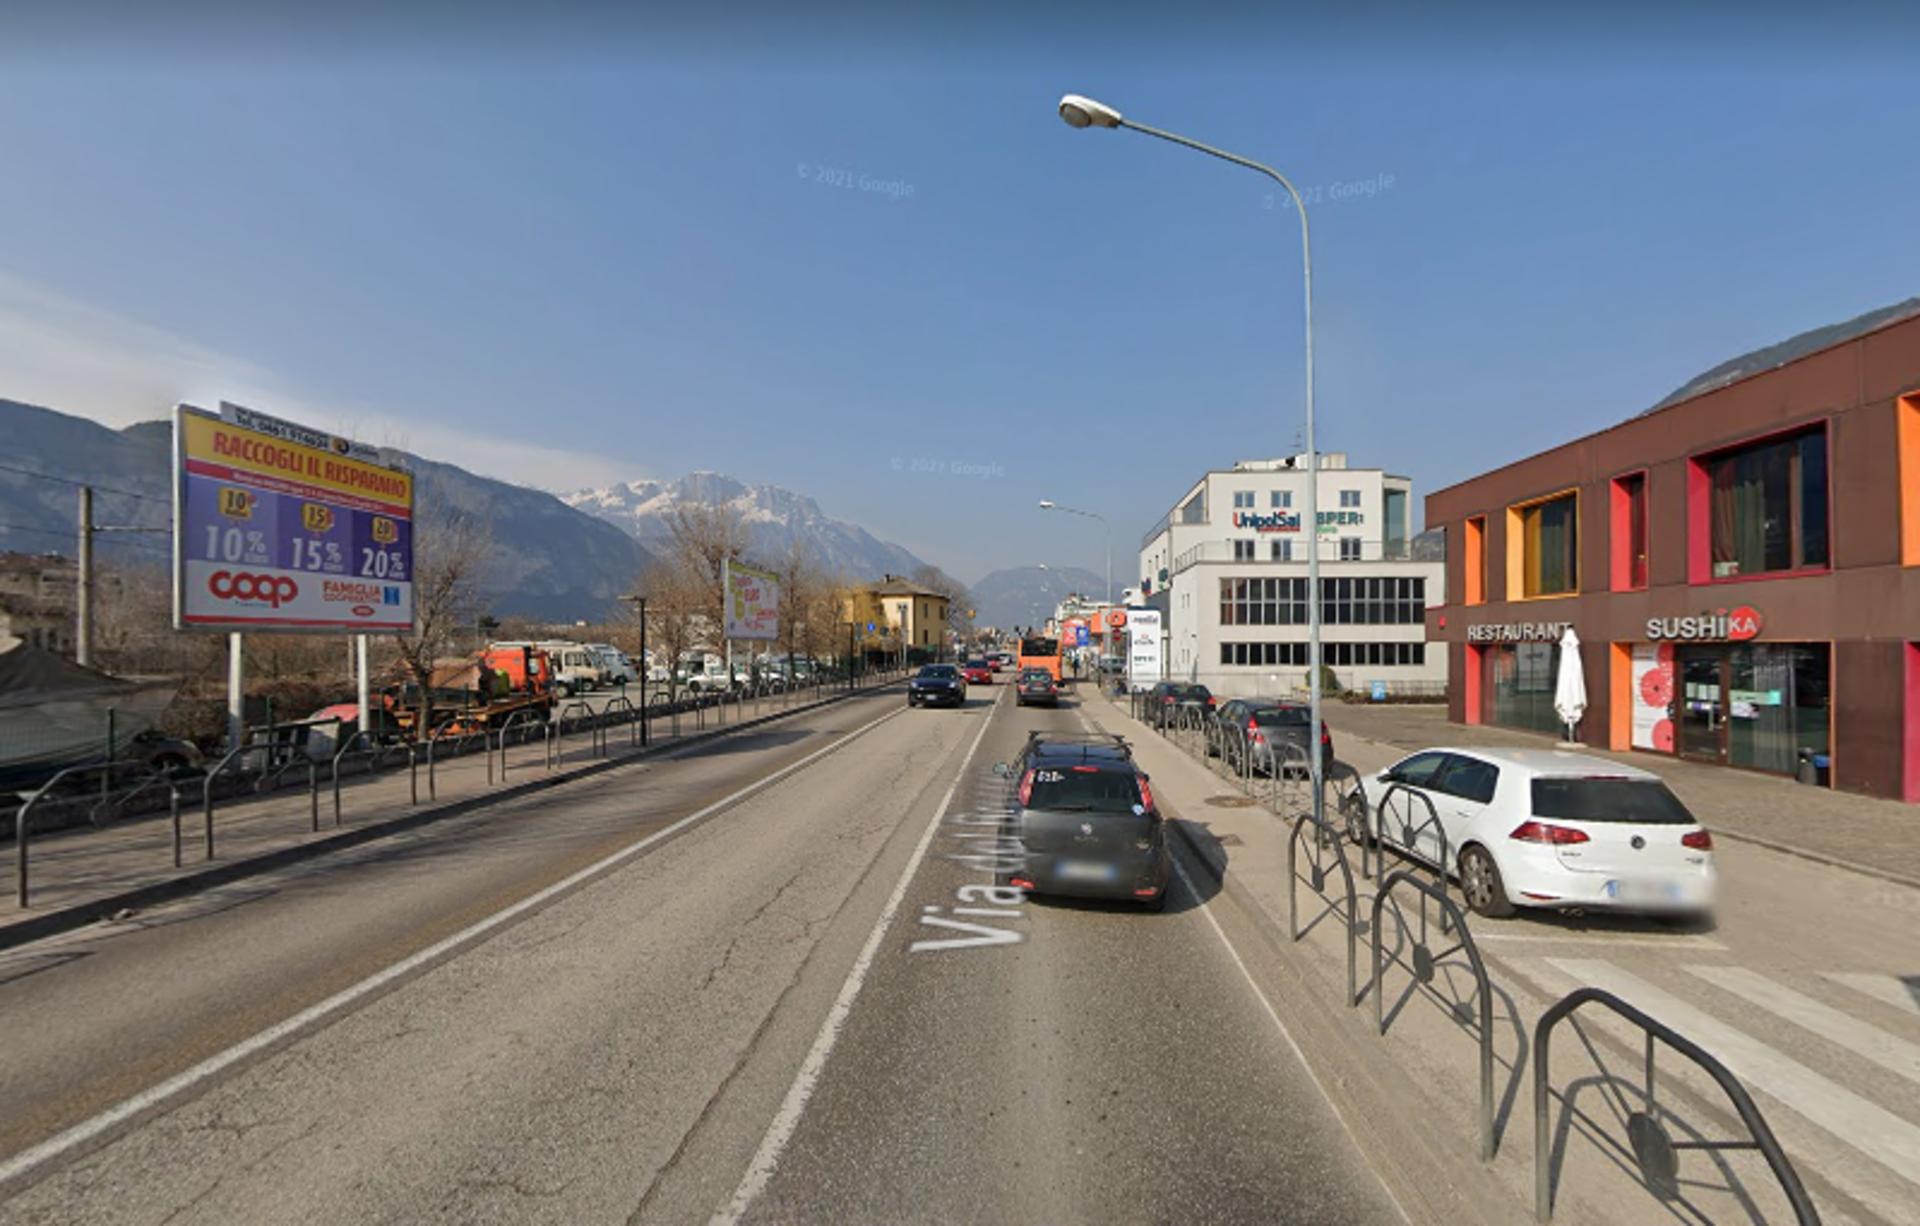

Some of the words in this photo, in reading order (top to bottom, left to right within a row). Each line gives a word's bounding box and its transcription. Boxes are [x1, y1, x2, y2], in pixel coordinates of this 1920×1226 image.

[213, 431, 302, 474] RACCOGLI
[307, 456, 323, 479] IL
[324, 460, 407, 499] RISPARMIO
[322, 580, 380, 597] FAMIGLIA
[1467, 621, 1572, 641] RESTAURANT
